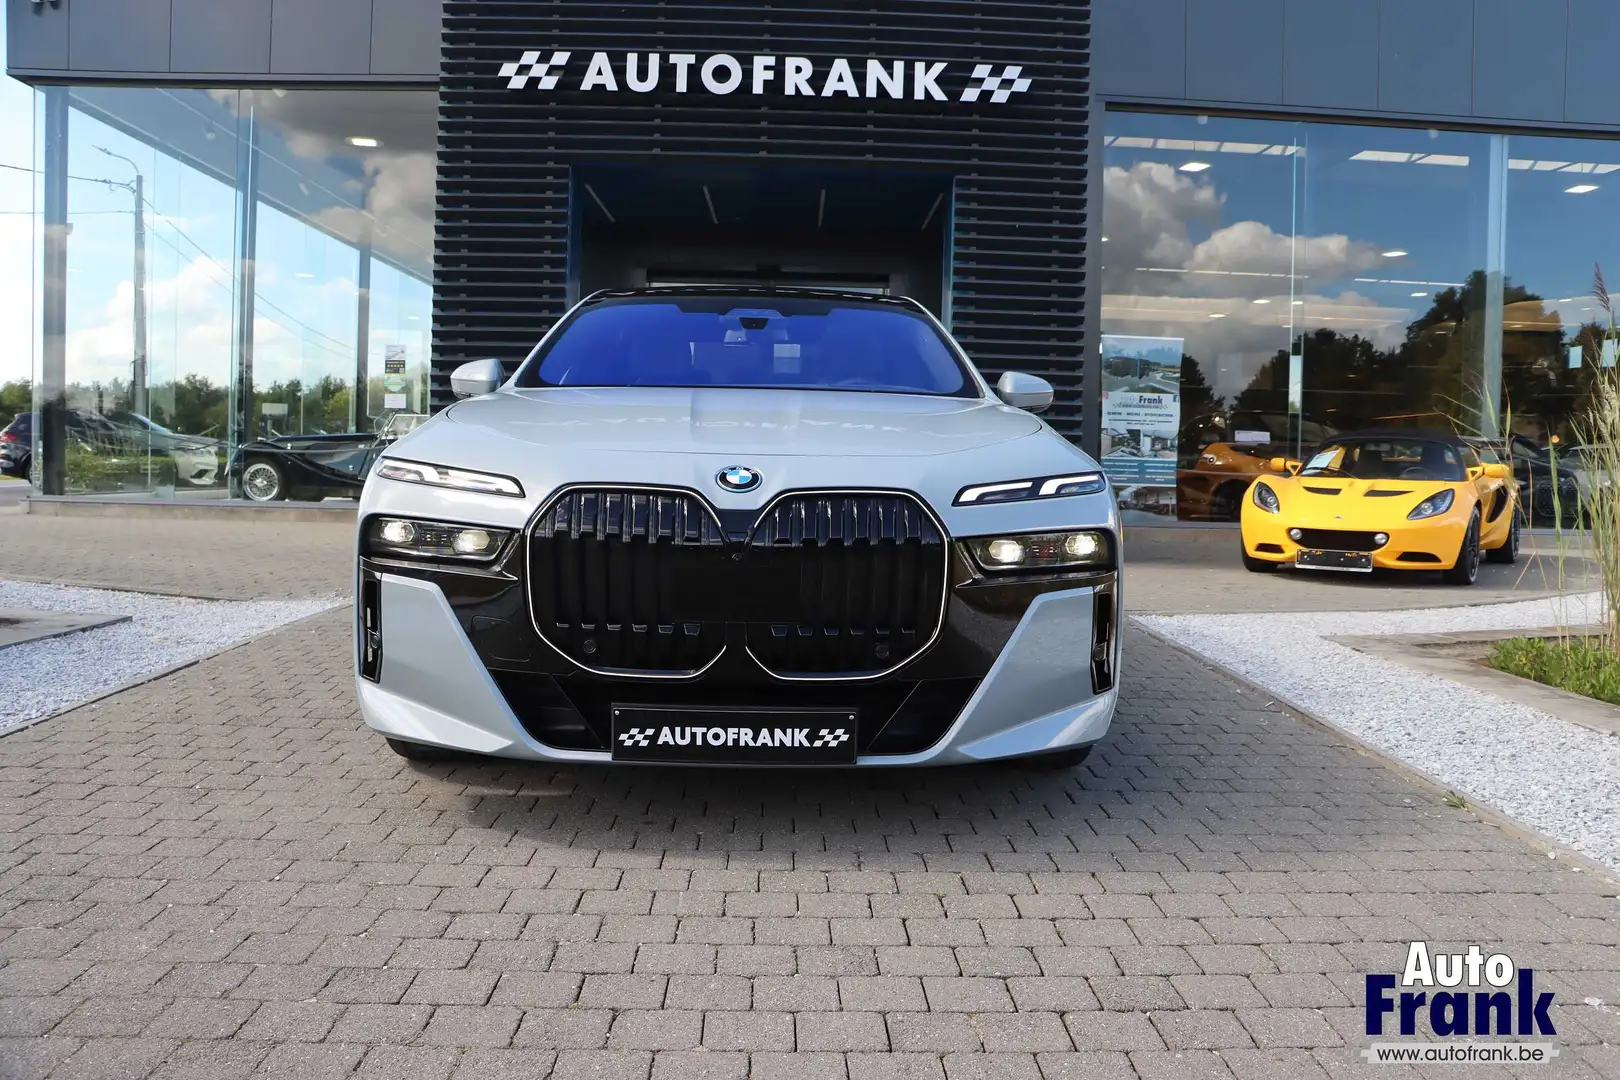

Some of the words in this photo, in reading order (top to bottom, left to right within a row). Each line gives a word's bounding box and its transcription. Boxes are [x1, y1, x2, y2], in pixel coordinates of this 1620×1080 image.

[579, 51, 949, 101] AUTOFRANK
[1139, 395, 1163, 404] Frank
[656, 726, 811, 747] AUTOFRANK
